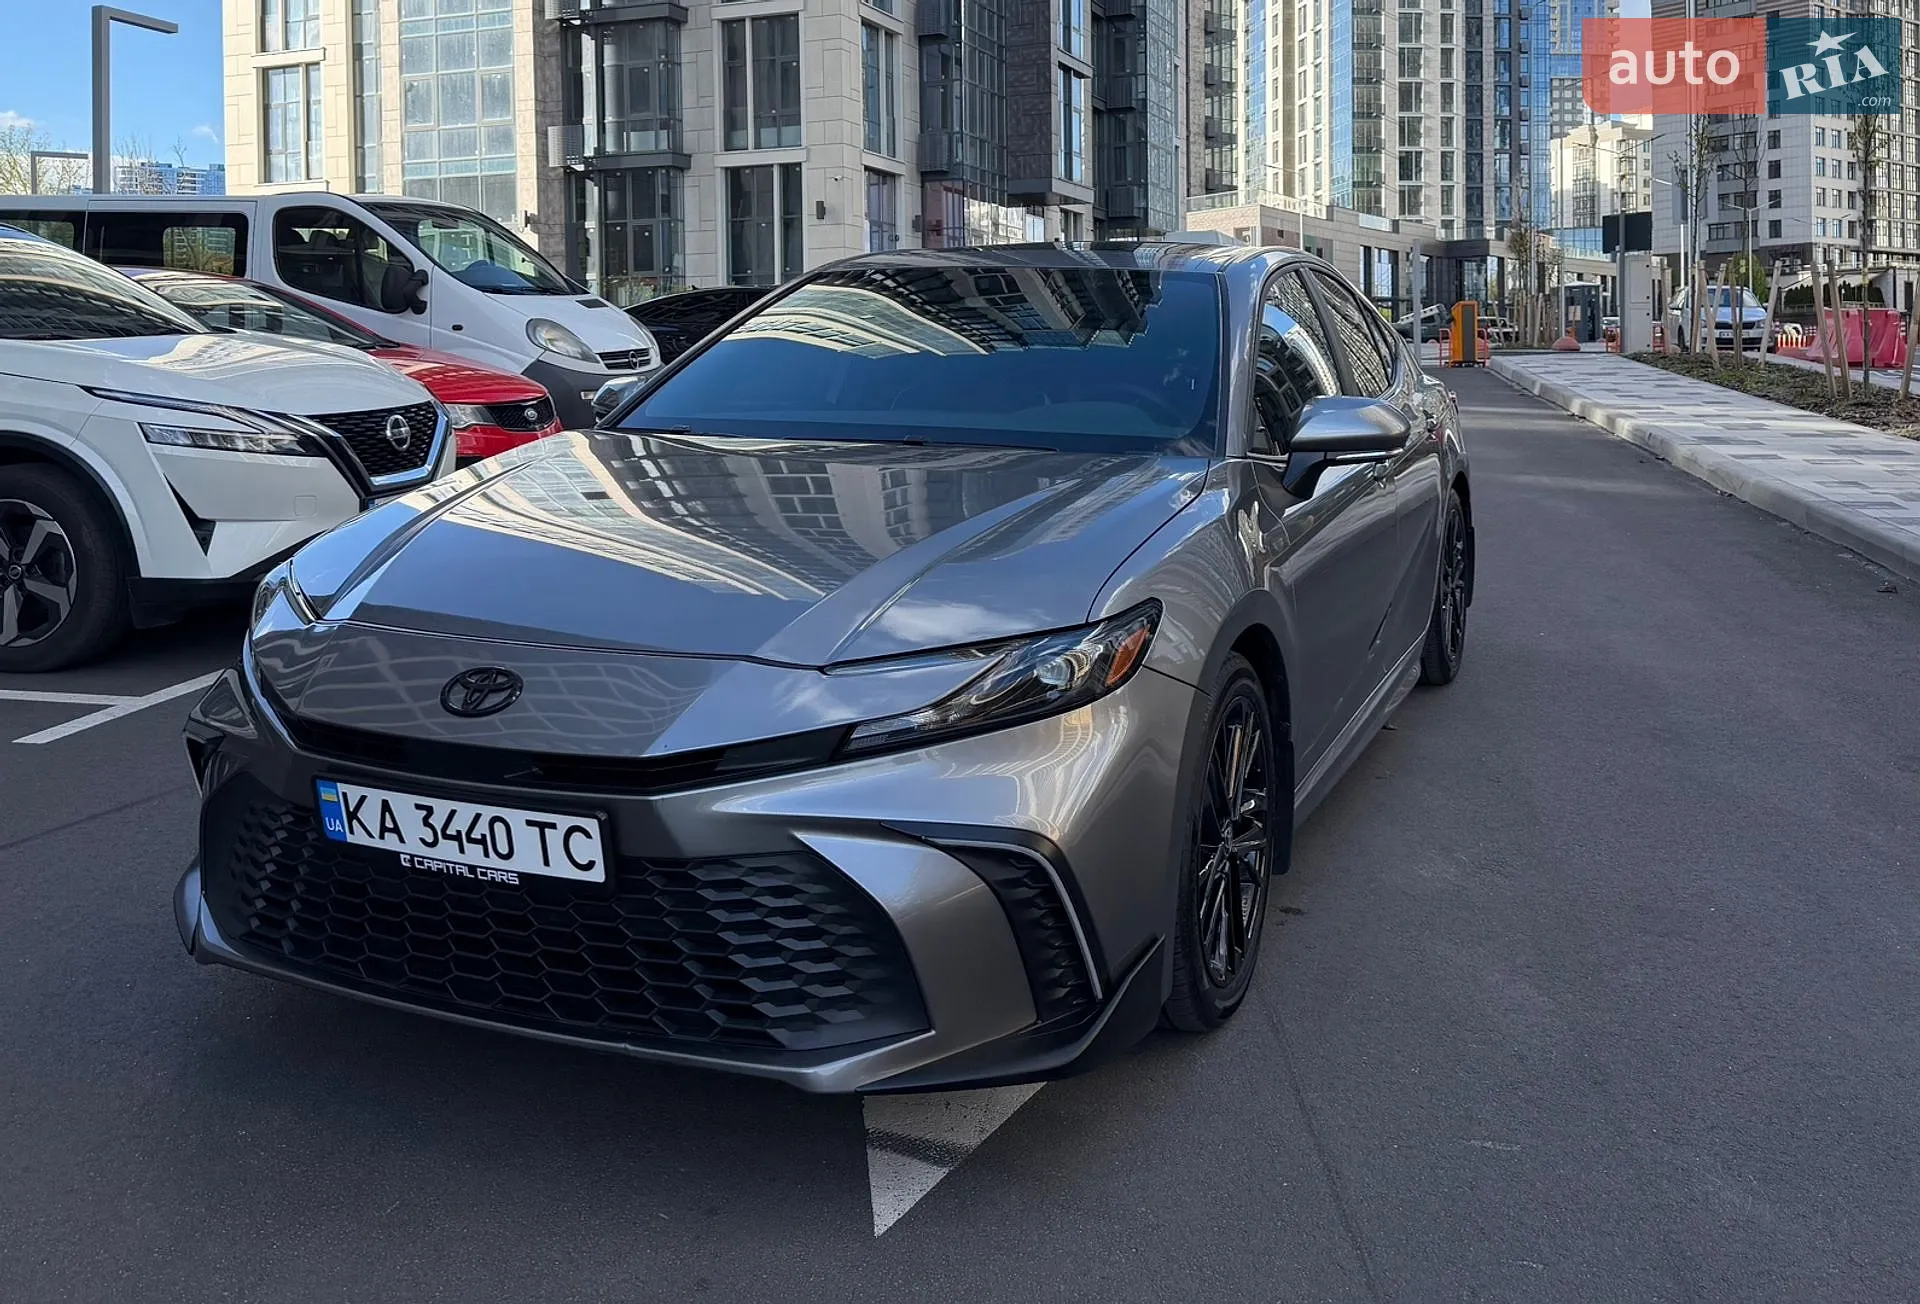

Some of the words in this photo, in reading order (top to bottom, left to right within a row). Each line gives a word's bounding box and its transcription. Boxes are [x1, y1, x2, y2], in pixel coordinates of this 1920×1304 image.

[325, 817, 344, 833] UA
[341, 791, 406, 844] KA
[414, 803, 515, 861] 3440
[525, 819, 597, 872] TC
[413, 856, 475, 878] CAPITAL
[477, 867, 520, 885] CARS
